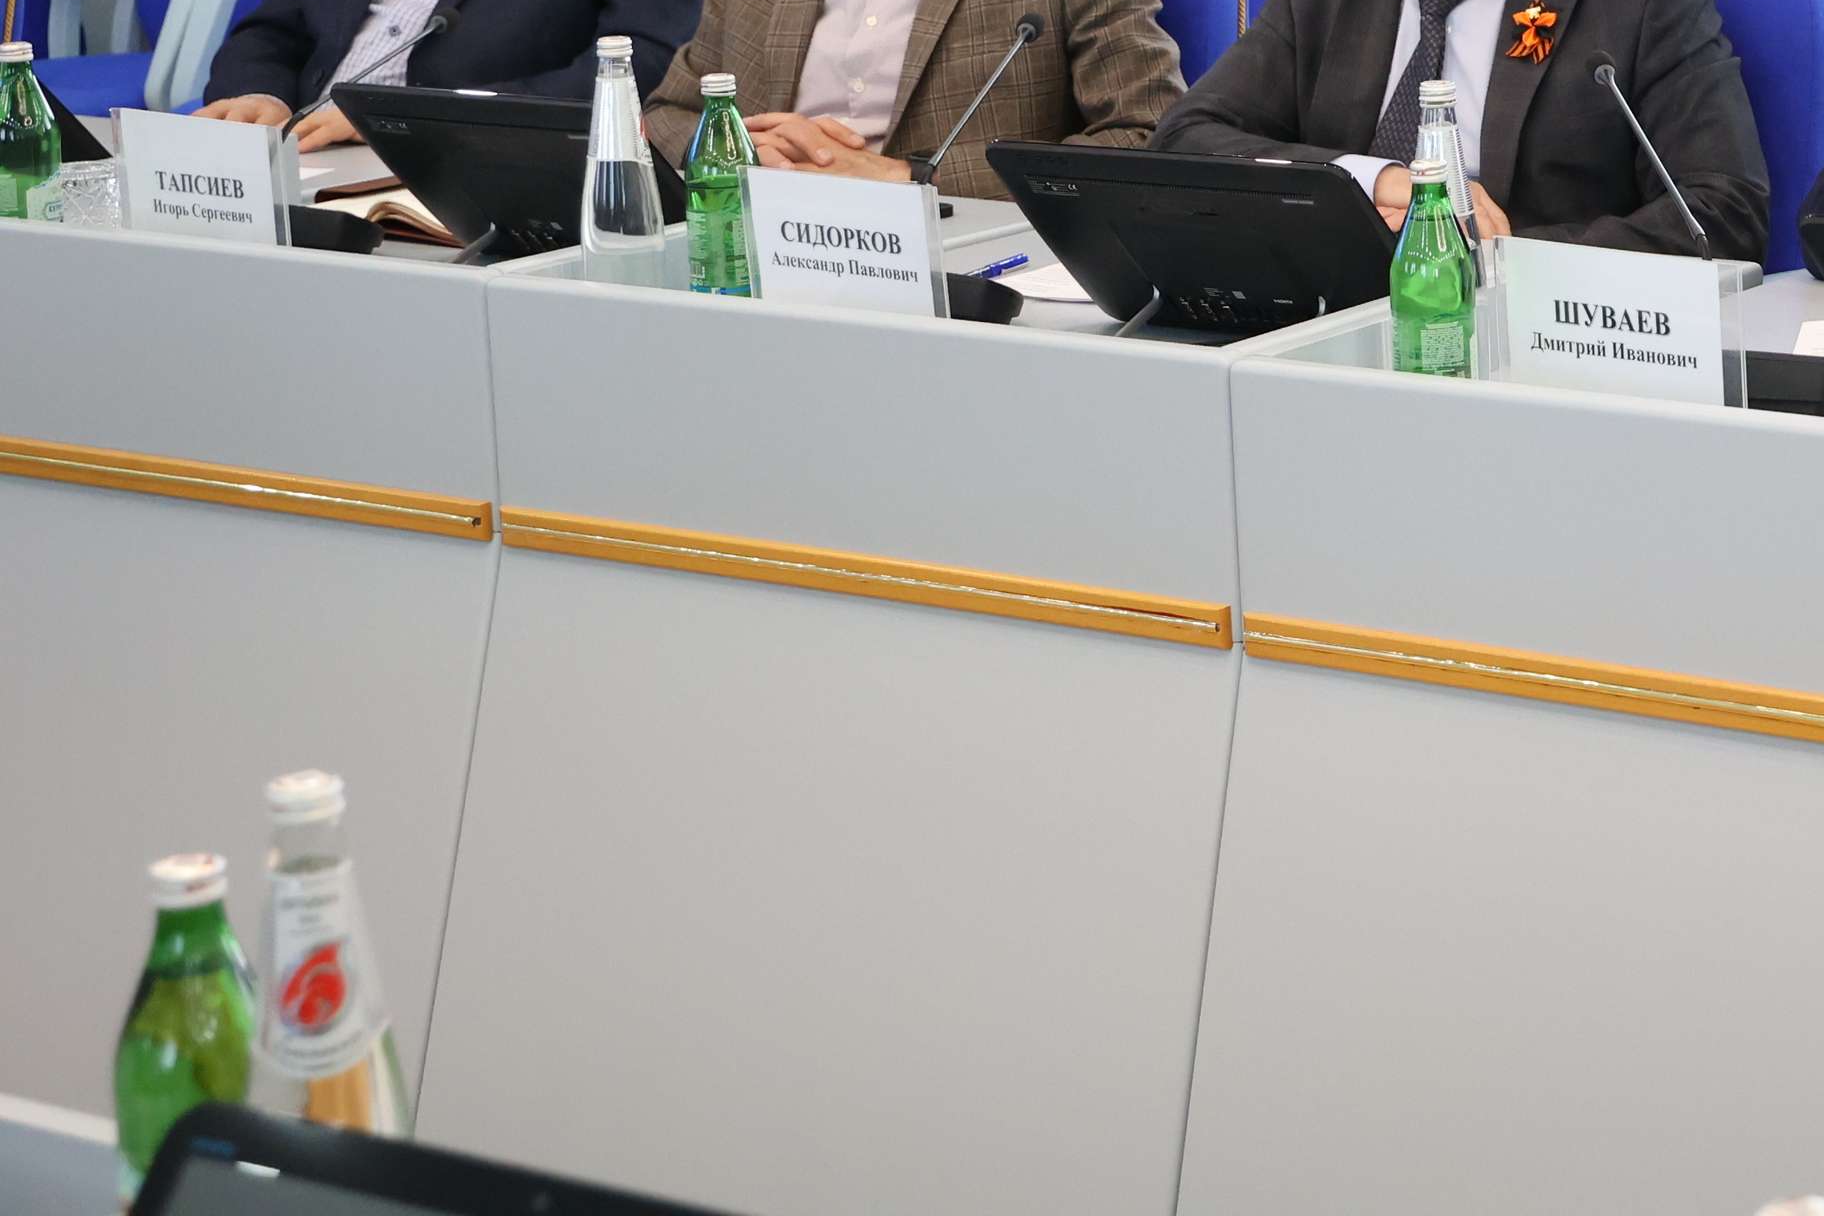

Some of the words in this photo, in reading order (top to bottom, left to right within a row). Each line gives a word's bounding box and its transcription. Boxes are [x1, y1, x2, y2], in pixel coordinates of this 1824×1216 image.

[154, 170, 245, 199] ТАПСИЕВ
[153, 198, 189, 217] Игорь
[191, 203, 253, 224] Сергеевич
[780, 220, 902, 255] СИДОРКОВ
[772, 251, 845, 278] Александр
[848, 259, 919, 283] Павлович
[1554, 299, 1671, 336] ШУВАЕВ
[1530, 331, 1606, 359] Дмитрий
[1612, 341, 1698, 369] Иванович
